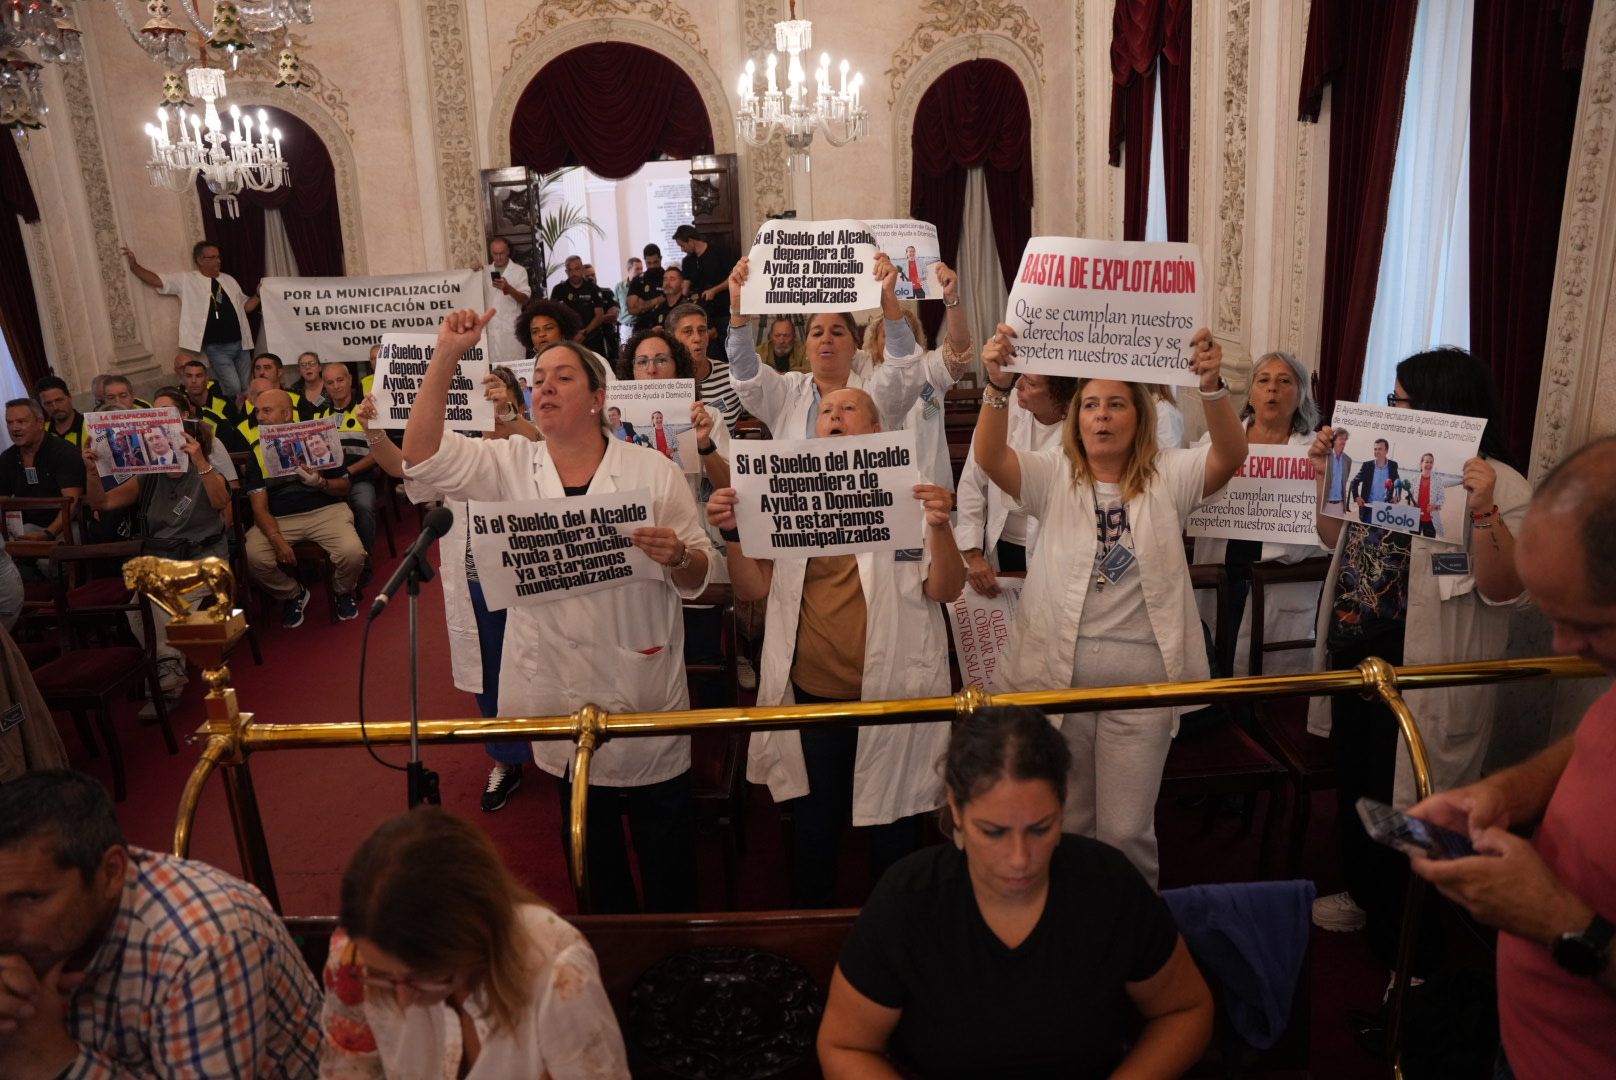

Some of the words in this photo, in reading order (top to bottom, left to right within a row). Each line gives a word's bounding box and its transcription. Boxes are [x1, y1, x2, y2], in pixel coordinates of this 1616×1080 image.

[763, 230, 774, 244] el
[777, 230, 814, 246] Sueldo
[818, 230, 834, 246] del
[773, 245, 838, 262] dependiera
[840, 246, 854, 260] de
[763, 261, 800, 278] Ayuda
[802, 262, 810, 274] a
[813, 260, 864, 275] Domicilio
[1021, 253, 1065, 287] BASTA
[1069, 256, 1089, 289] DE
[1092, 255, 1196, 294] EXPLOTACIÓN
[283, 290, 312, 300] POR
[316, 289, 332, 300] LA
[336, 280, 462, 298] MUNICIPALIZACIÓN
[770, 276, 784, 290] ya
[787, 274, 855, 289] estaríamos
[895, 288, 910, 296] olo
[293, 306, 301, 316] Y
[305, 306, 320, 316] LA
[325, 299, 426, 316] DIGNIFICACIÓN
[430, 300, 454, 310] DEL
[765, 289, 858, 306] municipalizadas
[305, 320, 364, 332] SERVICIO
[370, 319, 387, 330] DE
[392, 317, 434, 328] AYUDA
[1016, 298, 1042, 326] Que
[1046, 308, 1059, 320] se
[1063, 303, 1126, 325] cumplan
[1132, 311, 1194, 330] nuestros
[343, 336, 382, 346] DOMIC
[1022, 322, 1084, 342] derechos
[1088, 324, 1152, 348] laborales
[1155, 336, 1164, 354] y
[1166, 337, 1181, 350] se
[392, 344, 422, 360] Sueldo
[425, 346, 435, 360] de
[1013, 342, 1064, 364] espeten
[1069, 346, 1128, 366] nuestros
[1130, 350, 1189, 370] acuerdo
[390, 360, 429, 376] dependi
[383, 376, 416, 392] Ayuda
[391, 392, 406, 406] ya
[1342, 406, 1383, 418] Ayuntamiento
[1450, 418, 1460, 428] de
[1372, 422, 1380, 430] de
[1380, 423, 1406, 433] contrato
[1407, 426, 1416, 434] de
[1416, 427, 1437, 438] Ayuda
[736, 454, 750, 474] Si
[754, 454, 766, 474] el
[770, 453, 821, 474] Sueldo
[825, 450, 848, 472] del
[853, 446, 910, 470] Alcalde
[769, 473, 856, 495] dependiera
[860, 470, 878, 490] de
[760, 493, 808, 515] Ayuda
[812, 494, 822, 510] a
[825, 489, 893, 510] Domicilio
[1230, 486, 1274, 502] cumplan
[1278, 492, 1316, 504] nuestro
[474, 515, 488, 534] Si
[491, 514, 505, 534] el
[508, 512, 559, 533] Sueldo
[562, 509, 586, 528] del
[591, 503, 647, 524] Alcalde
[772, 514, 792, 532] ya
[795, 509, 884, 529] estaríamos
[1248, 502, 1292, 520] laborales
[1294, 510, 1300, 524] y
[1302, 511, 1312, 520] se
[1190, 516, 1231, 531] respeten
[1234, 518, 1276, 532] nuestros
[1278, 520, 1316, 534] acuerdo
[509, 526, 596, 552] dependiera
[598, 524, 618, 538] de
[771, 526, 890, 548] municipalizadas
[502, 550, 549, 568] Ayuda
[553, 546, 564, 560] a
[567, 536, 633, 559] Domicilio
[515, 566, 536, 584] ya
[538, 552, 626, 578] estaríamos
[515, 564, 633, 597] municipalizadas
[973, 608, 994, 656] COBRAR
